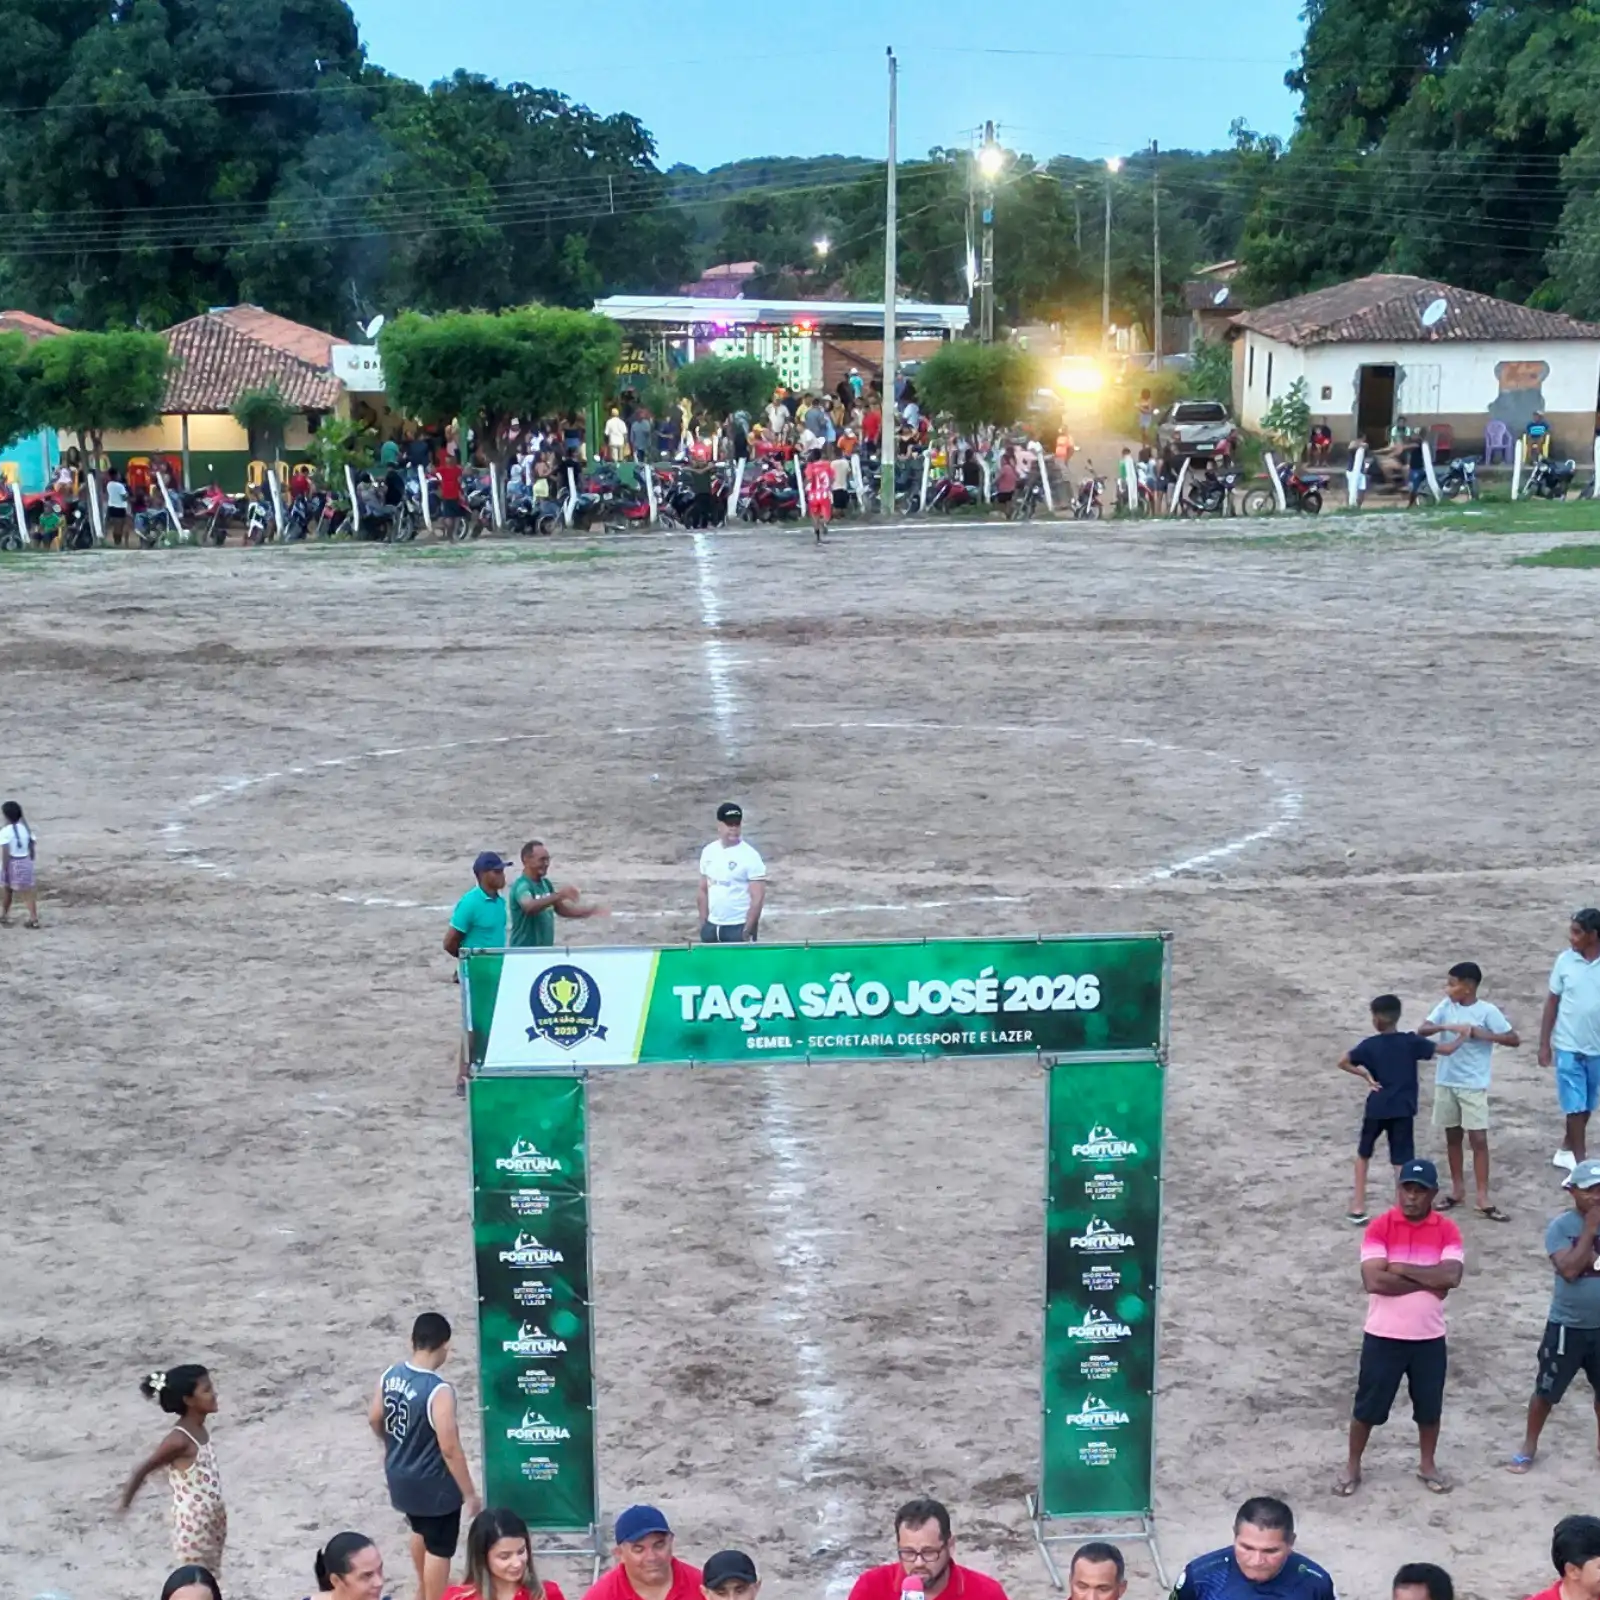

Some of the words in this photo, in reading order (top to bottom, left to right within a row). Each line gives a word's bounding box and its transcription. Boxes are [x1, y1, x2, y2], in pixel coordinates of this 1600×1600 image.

[673, 983, 796, 1032] TAÇA
[799, 972, 891, 1018] SÃO
[894, 965, 1000, 1016] JOSÉ
[1002, 974, 1101, 1013] 2026
[746, 1037, 793, 1049] SEMEL
[808, 1034, 894, 1048] SECRETARIA
[991, 1030, 1033, 1043] LAZER
